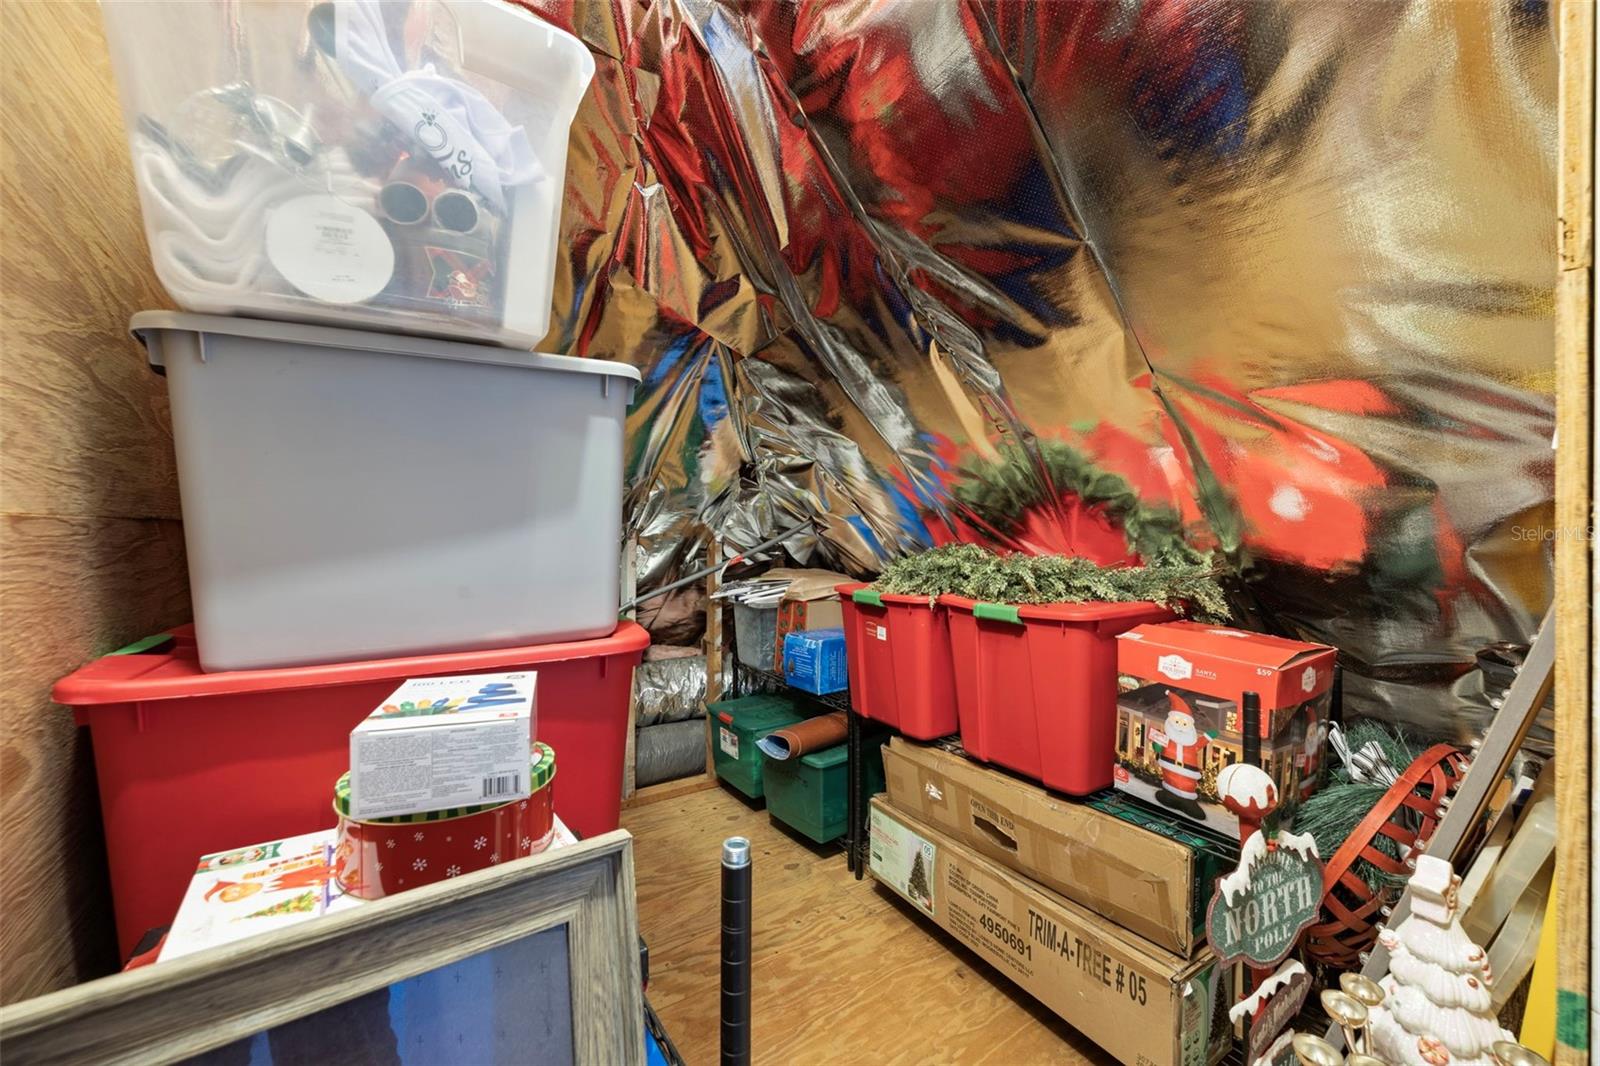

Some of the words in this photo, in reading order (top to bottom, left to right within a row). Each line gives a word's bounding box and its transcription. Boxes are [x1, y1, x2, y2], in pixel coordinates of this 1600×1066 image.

[1256, 667, 1272, 677] $59
[1223, 874, 1313, 947] NORTH
[980, 914, 1032, 962] 4950691
[1028, 909, 1112, 987] TRIM-A-TREE
[1116, 963, 1125, 994] #
[1129, 971, 1147, 1006] 05
[1253, 922, 1291, 954] POLE
